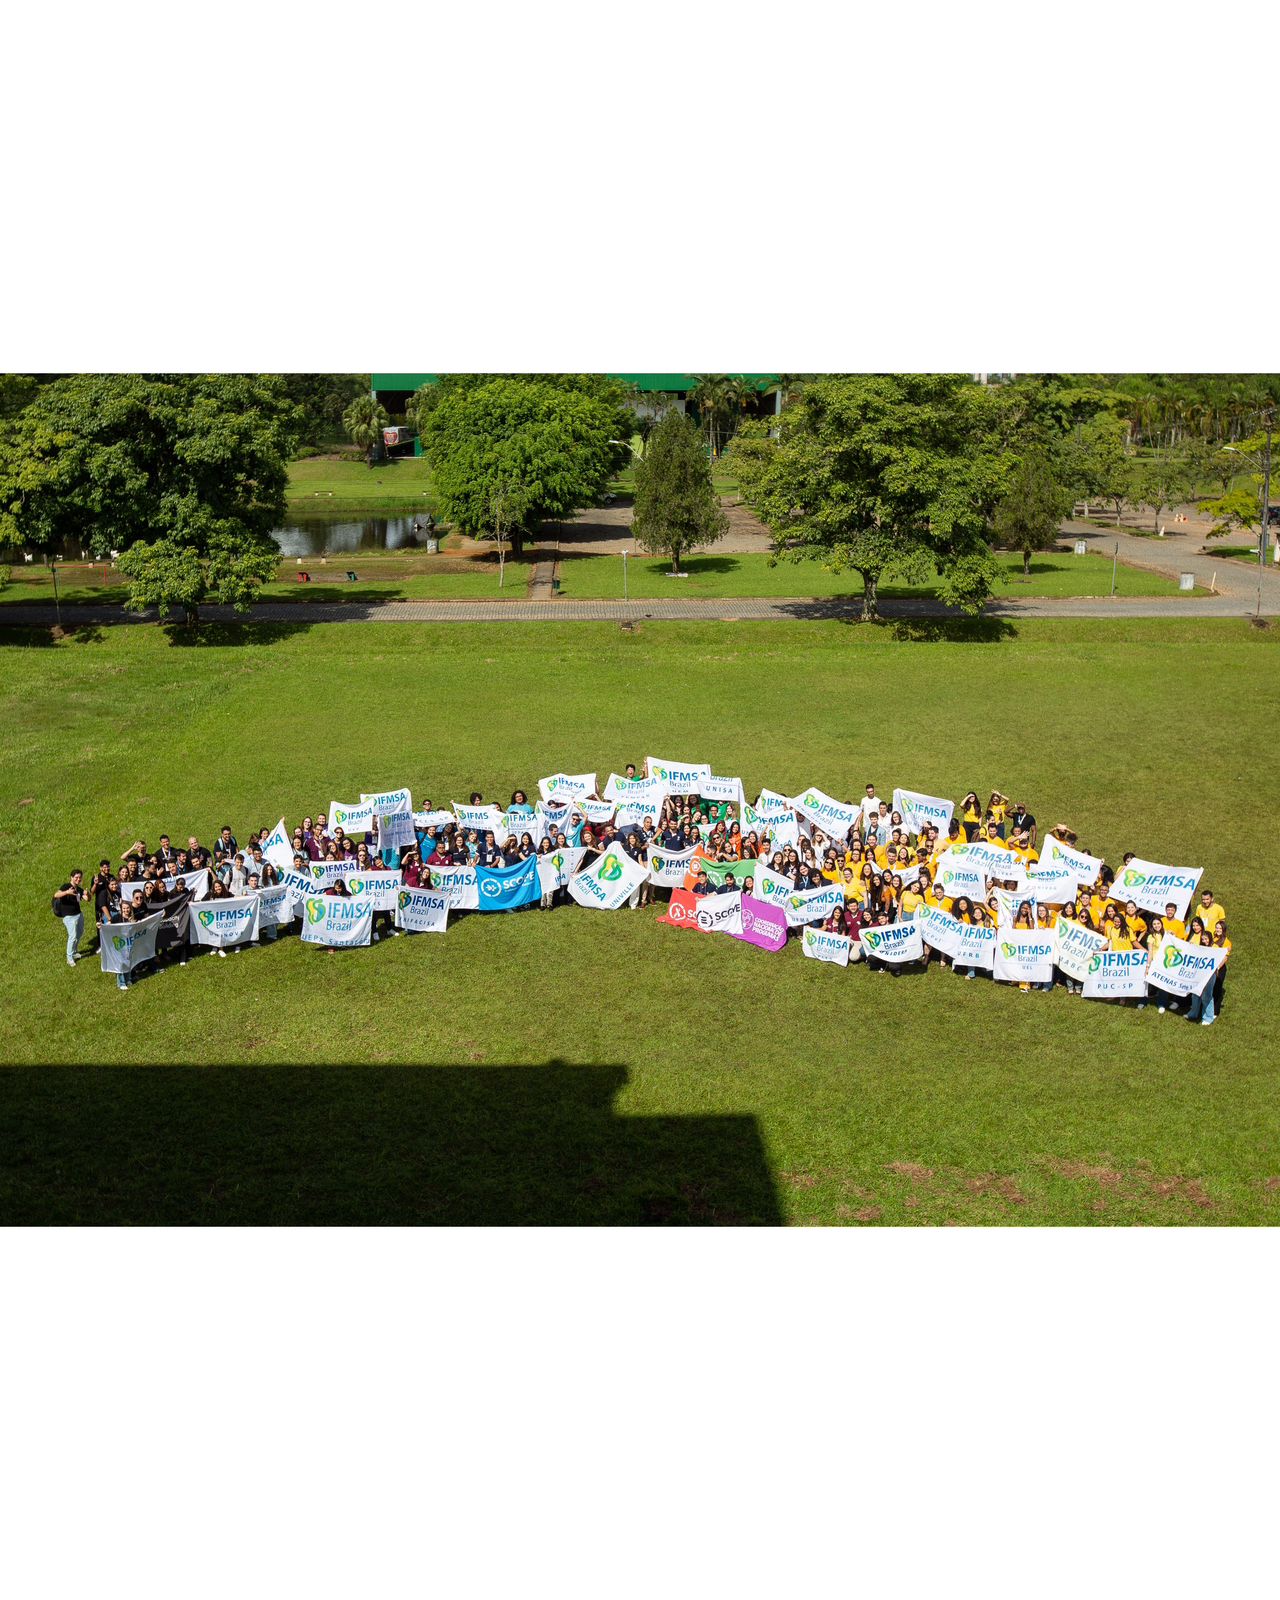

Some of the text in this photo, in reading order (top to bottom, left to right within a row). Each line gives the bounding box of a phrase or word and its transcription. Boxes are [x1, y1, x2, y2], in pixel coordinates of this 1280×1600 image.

[558, 777, 585, 789] IFMSA
[627, 777, 657, 790] IFMSA
[705, 786, 733, 794] UNISA
[378, 792, 406, 805] IFMSA
[348, 807, 373, 820] IFMSA
[818, 803, 853, 822] IFMSA
[915, 803, 947, 818] IFMSA
[392, 813, 410, 823] IFMSA
[509, 814, 538, 823] IFMSA
[969, 846, 1012, 864] IFMSA
[325, 862, 355, 873] IFMSA
[442, 874, 478, 886] IFMSA
[503, 873, 536, 890] SCOPE
[955, 872, 979, 882] IFMSA
[1146, 875, 1196, 891] IFMSA
[365, 880, 399, 891] IFMSA
[574, 878, 592, 896] Brazil
[580, 873, 607, 901] IFMSA
[1141, 886, 1170, 896] Brazil
[263, 894, 286, 907] IFMSA
[610, 882, 635, 908] UNIVILLE
[412, 895, 445, 910] IFMSA
[806, 904, 827, 913] Brazil
[216, 908, 253, 921] IFMSA
[328, 902, 373, 920] IFMSA
[410, 906, 430, 916] Brazil
[216, 920, 237, 929] Brazil
[326, 920, 352, 931] Brazil
[930, 912, 963, 937] IFMSA
[881, 925, 916, 942] IFMSA
[817, 936, 848, 950] IFMSA
[883, 941, 905, 950] Brazil
[961, 938, 982, 948] Brazil
[1061, 940, 1087, 958] Brazil
[1018, 945, 1052, 955] IFMSA
[1018, 955, 1038, 963] Brazil
[1103, 953, 1149, 967] IFMSA
[1182, 954, 1215, 970] IFMSA
[1102, 967, 1130, 977] Brazil
[1151, 971, 1177, 986] ATENAS
